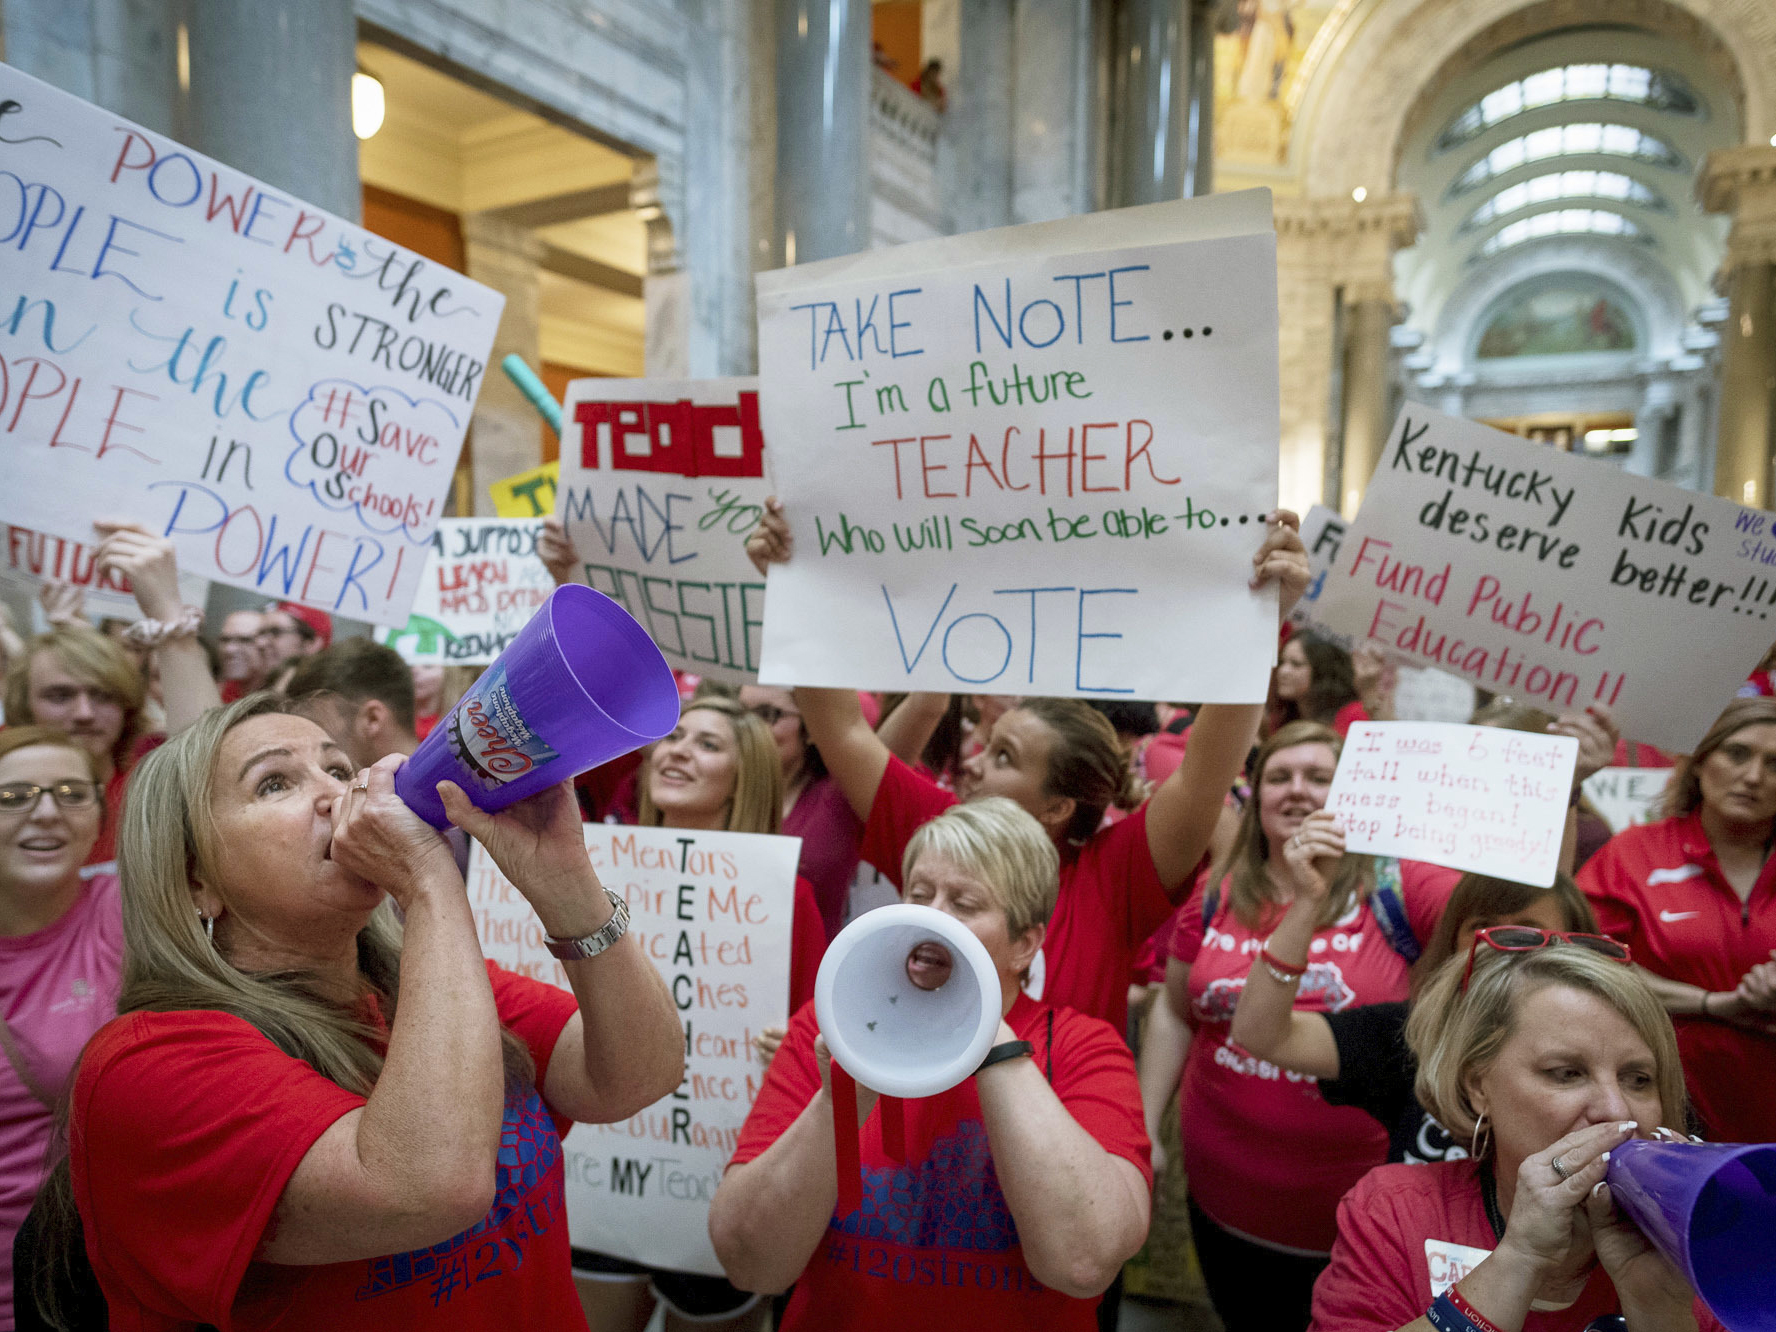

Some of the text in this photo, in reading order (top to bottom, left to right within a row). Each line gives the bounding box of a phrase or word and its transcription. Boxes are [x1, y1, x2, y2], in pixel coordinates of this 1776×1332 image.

[110, 126, 336, 266] POWER
[340, 239, 481, 323] the
[126, 307, 289, 422] the
[223, 267, 274, 331] is
[315, 303, 484, 401] STRONGER
[790, 288, 925, 371] TAKE
[834, 361, 1094, 430] I'm a future
[200, 423, 255, 490] in
[311, 432, 379, 478] Our
[871, 419, 1182, 500] TEACHER
[1393, 417, 1710, 556] Kentucky Kids
[147, 480, 404, 616] POWER!
[564, 484, 699, 566] MADE
[698, 487, 763, 547] yo
[815, 512, 885, 556] Who
[894, 515, 953, 551] will
[1047, 507, 1098, 542] be
[1103, 506, 1169, 538] able
[1418, 489, 1581, 569] deserve
[8, 525, 135, 594] FUTU
[1350, 536, 1452, 606] Fund
[881, 582, 1138, 693] VOTE
[462, 692, 534, 775] Cheer
[1356, 730, 1384, 753] I
[1396, 738, 1442, 756] was
[1337, 791, 1401, 809] mess
[1348, 760, 1400, 782] tall
[1417, 763, 1490, 793] when
[1395, 814, 1456, 855] being
[611, 1156, 653, 1198] MY
